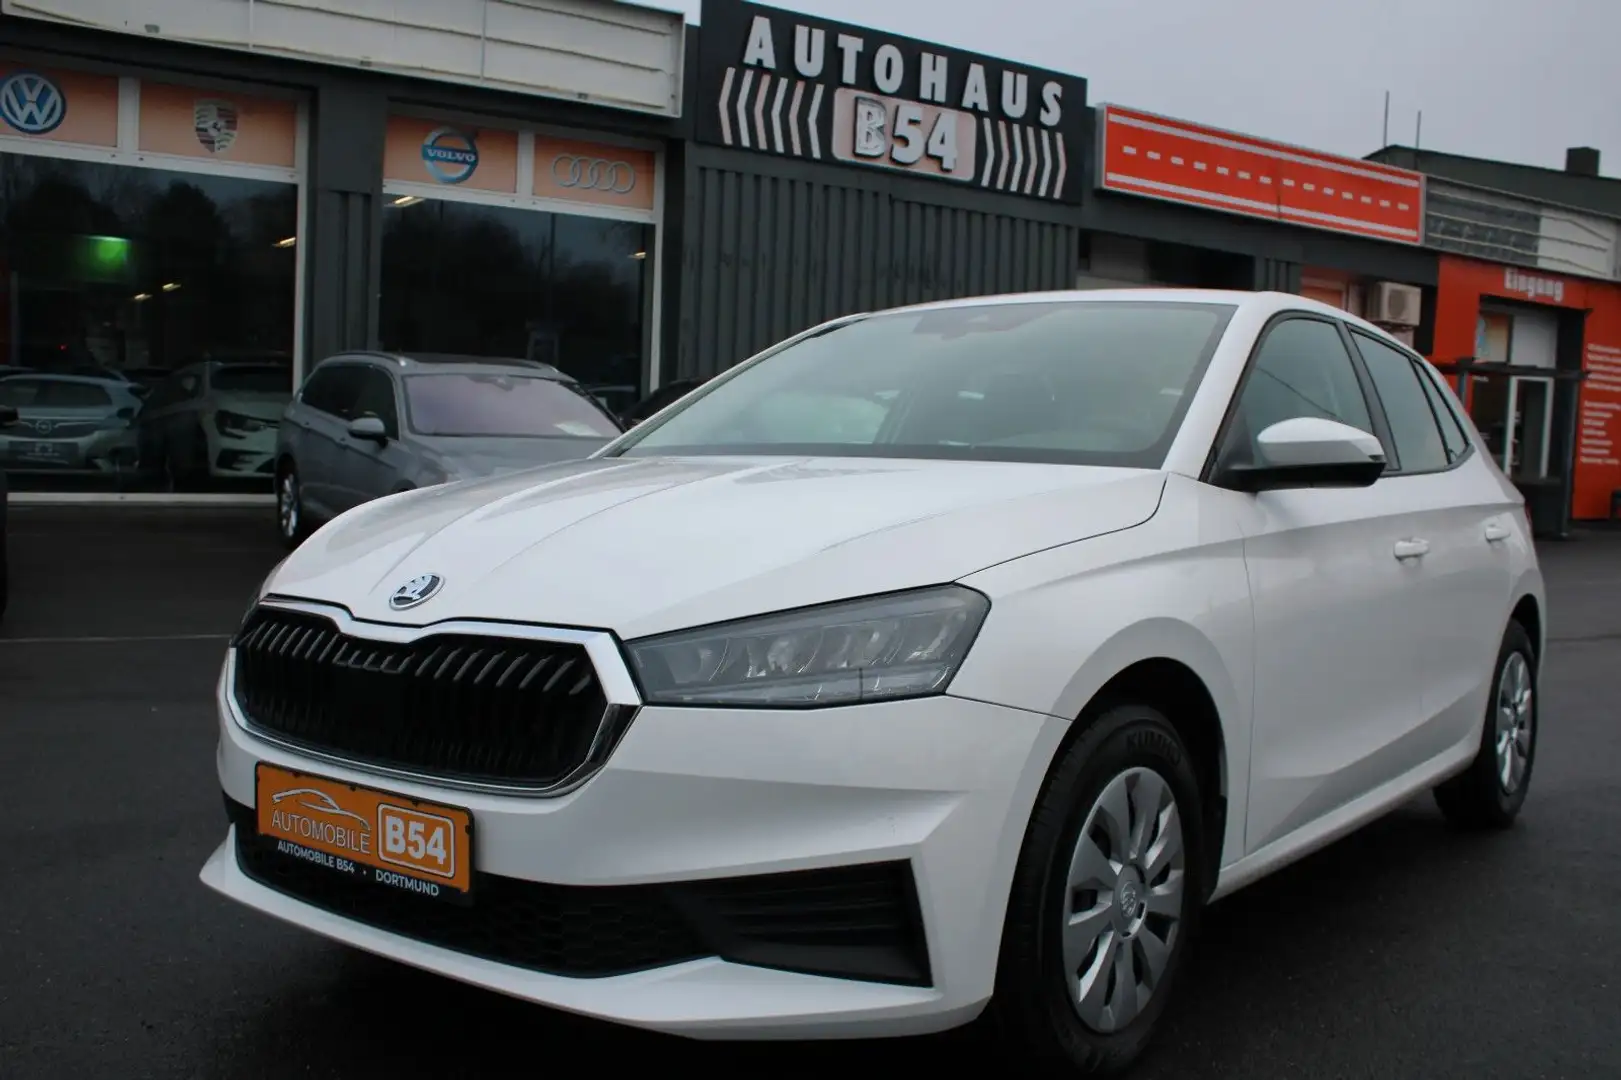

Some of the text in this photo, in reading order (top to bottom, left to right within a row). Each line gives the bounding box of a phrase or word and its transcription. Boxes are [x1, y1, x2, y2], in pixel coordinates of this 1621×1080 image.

[743, 15, 1063, 127] AUTOHAUS
[427, 148, 476, 162] VOLVO
[854, 97, 958, 172] B54
[1504, 269, 1565, 302] Eingang
[271, 809, 371, 855] AUTOMOBILE
[385, 814, 447, 865] B54
[277, 840, 440, 897] AUTOMOBILE B54 DORTMUND
